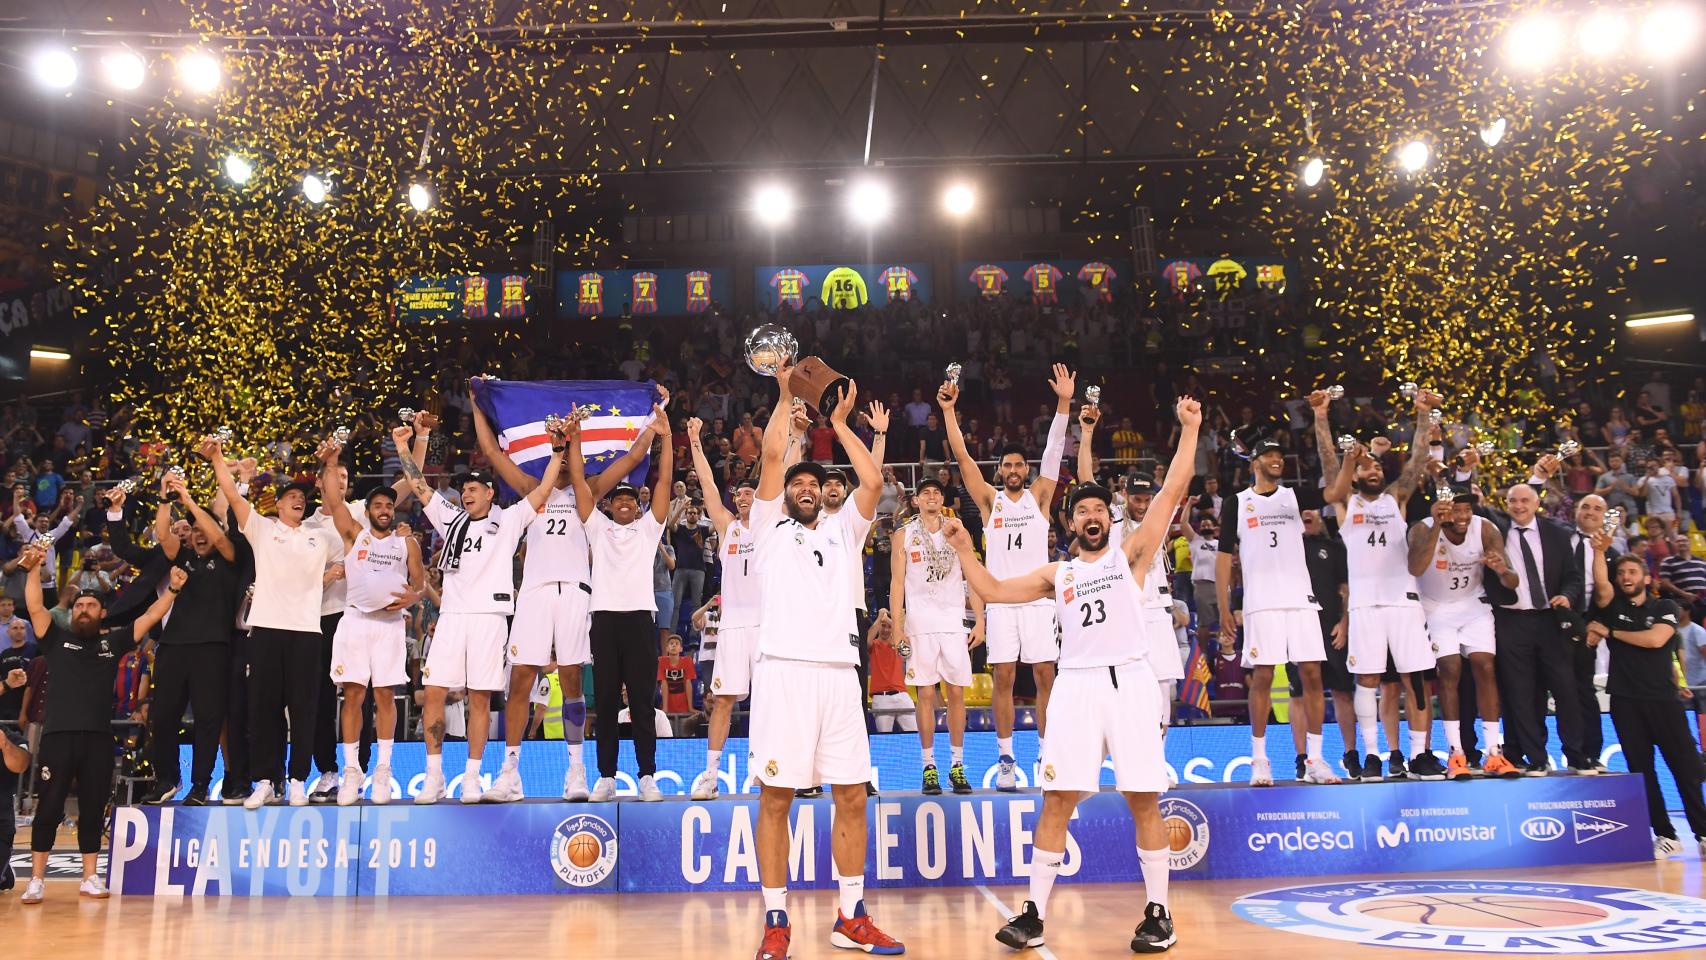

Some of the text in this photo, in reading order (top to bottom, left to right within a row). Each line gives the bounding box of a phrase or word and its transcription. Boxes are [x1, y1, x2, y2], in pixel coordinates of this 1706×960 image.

[692, 281, 705, 296] 4
[780, 279, 799, 294] 21
[834, 278, 854, 292] 16
[888, 277, 909, 291] 14
[983, 275, 995, 289] 7
[1038, 274, 1049, 288] 5
[504, 286, 522, 300] 12
[582, 283, 599, 298] 11
[638, 282, 650, 297] 7
[546, 518, 567, 536] 22
[463, 536, 483, 553] 24
[1007, 533, 1023, 551] 14
[1269, 531, 1278, 548] 3
[1367, 530, 1387, 547] 44
[1076, 573, 1124, 589] Universidad
[1449, 576, 1470, 590] 33
[1076, 583, 1112, 598] Europea
[1080, 599, 1107, 627] 23
[1256, 811, 1341, 821] PATROCINADOR PRINCIPAL
[1400, 808, 1420, 817] SOCIO
[1414, 825, 1497, 842] movistar
[1527, 822, 1559, 836] KIA
[1247, 826, 1354, 852] endesa
[108, 806, 410, 896] PLAYOFF
[239, 838, 349, 869] ENDESA
[368, 837, 437, 868] 2019
[560, 865, 607, 884] PLAYOFF
